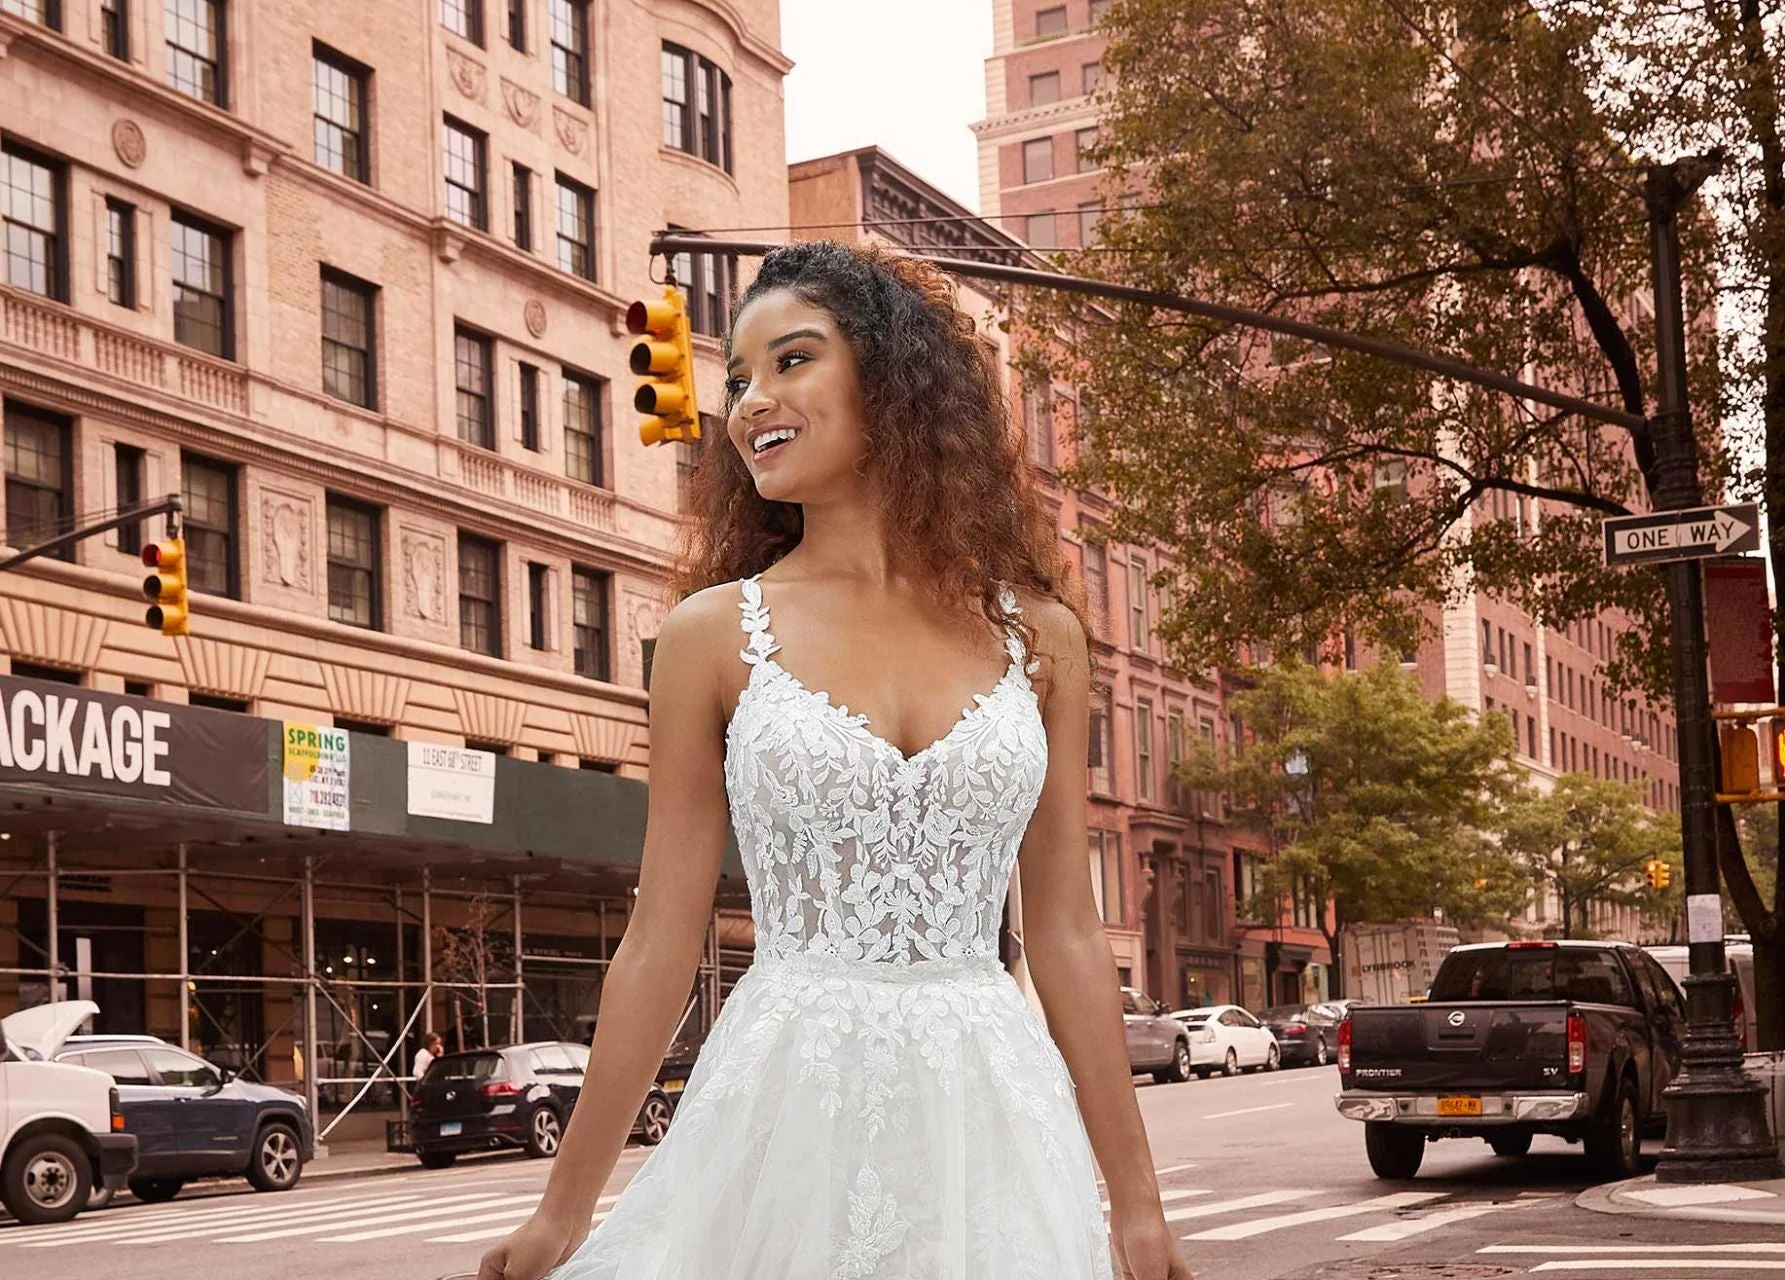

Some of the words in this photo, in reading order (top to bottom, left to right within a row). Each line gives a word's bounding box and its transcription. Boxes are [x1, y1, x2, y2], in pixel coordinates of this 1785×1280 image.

[1627, 528, 1669, 549] ONE
[1690, 521, 1734, 543] WAY
[288, 728, 345, 752] SPRING
[432, 748, 447, 768] EAST
[460, 752, 483, 773] STREET
[1355, 1068, 1402, 1077] FRONTIER
[1543, 1067, 1559, 1077] SV
